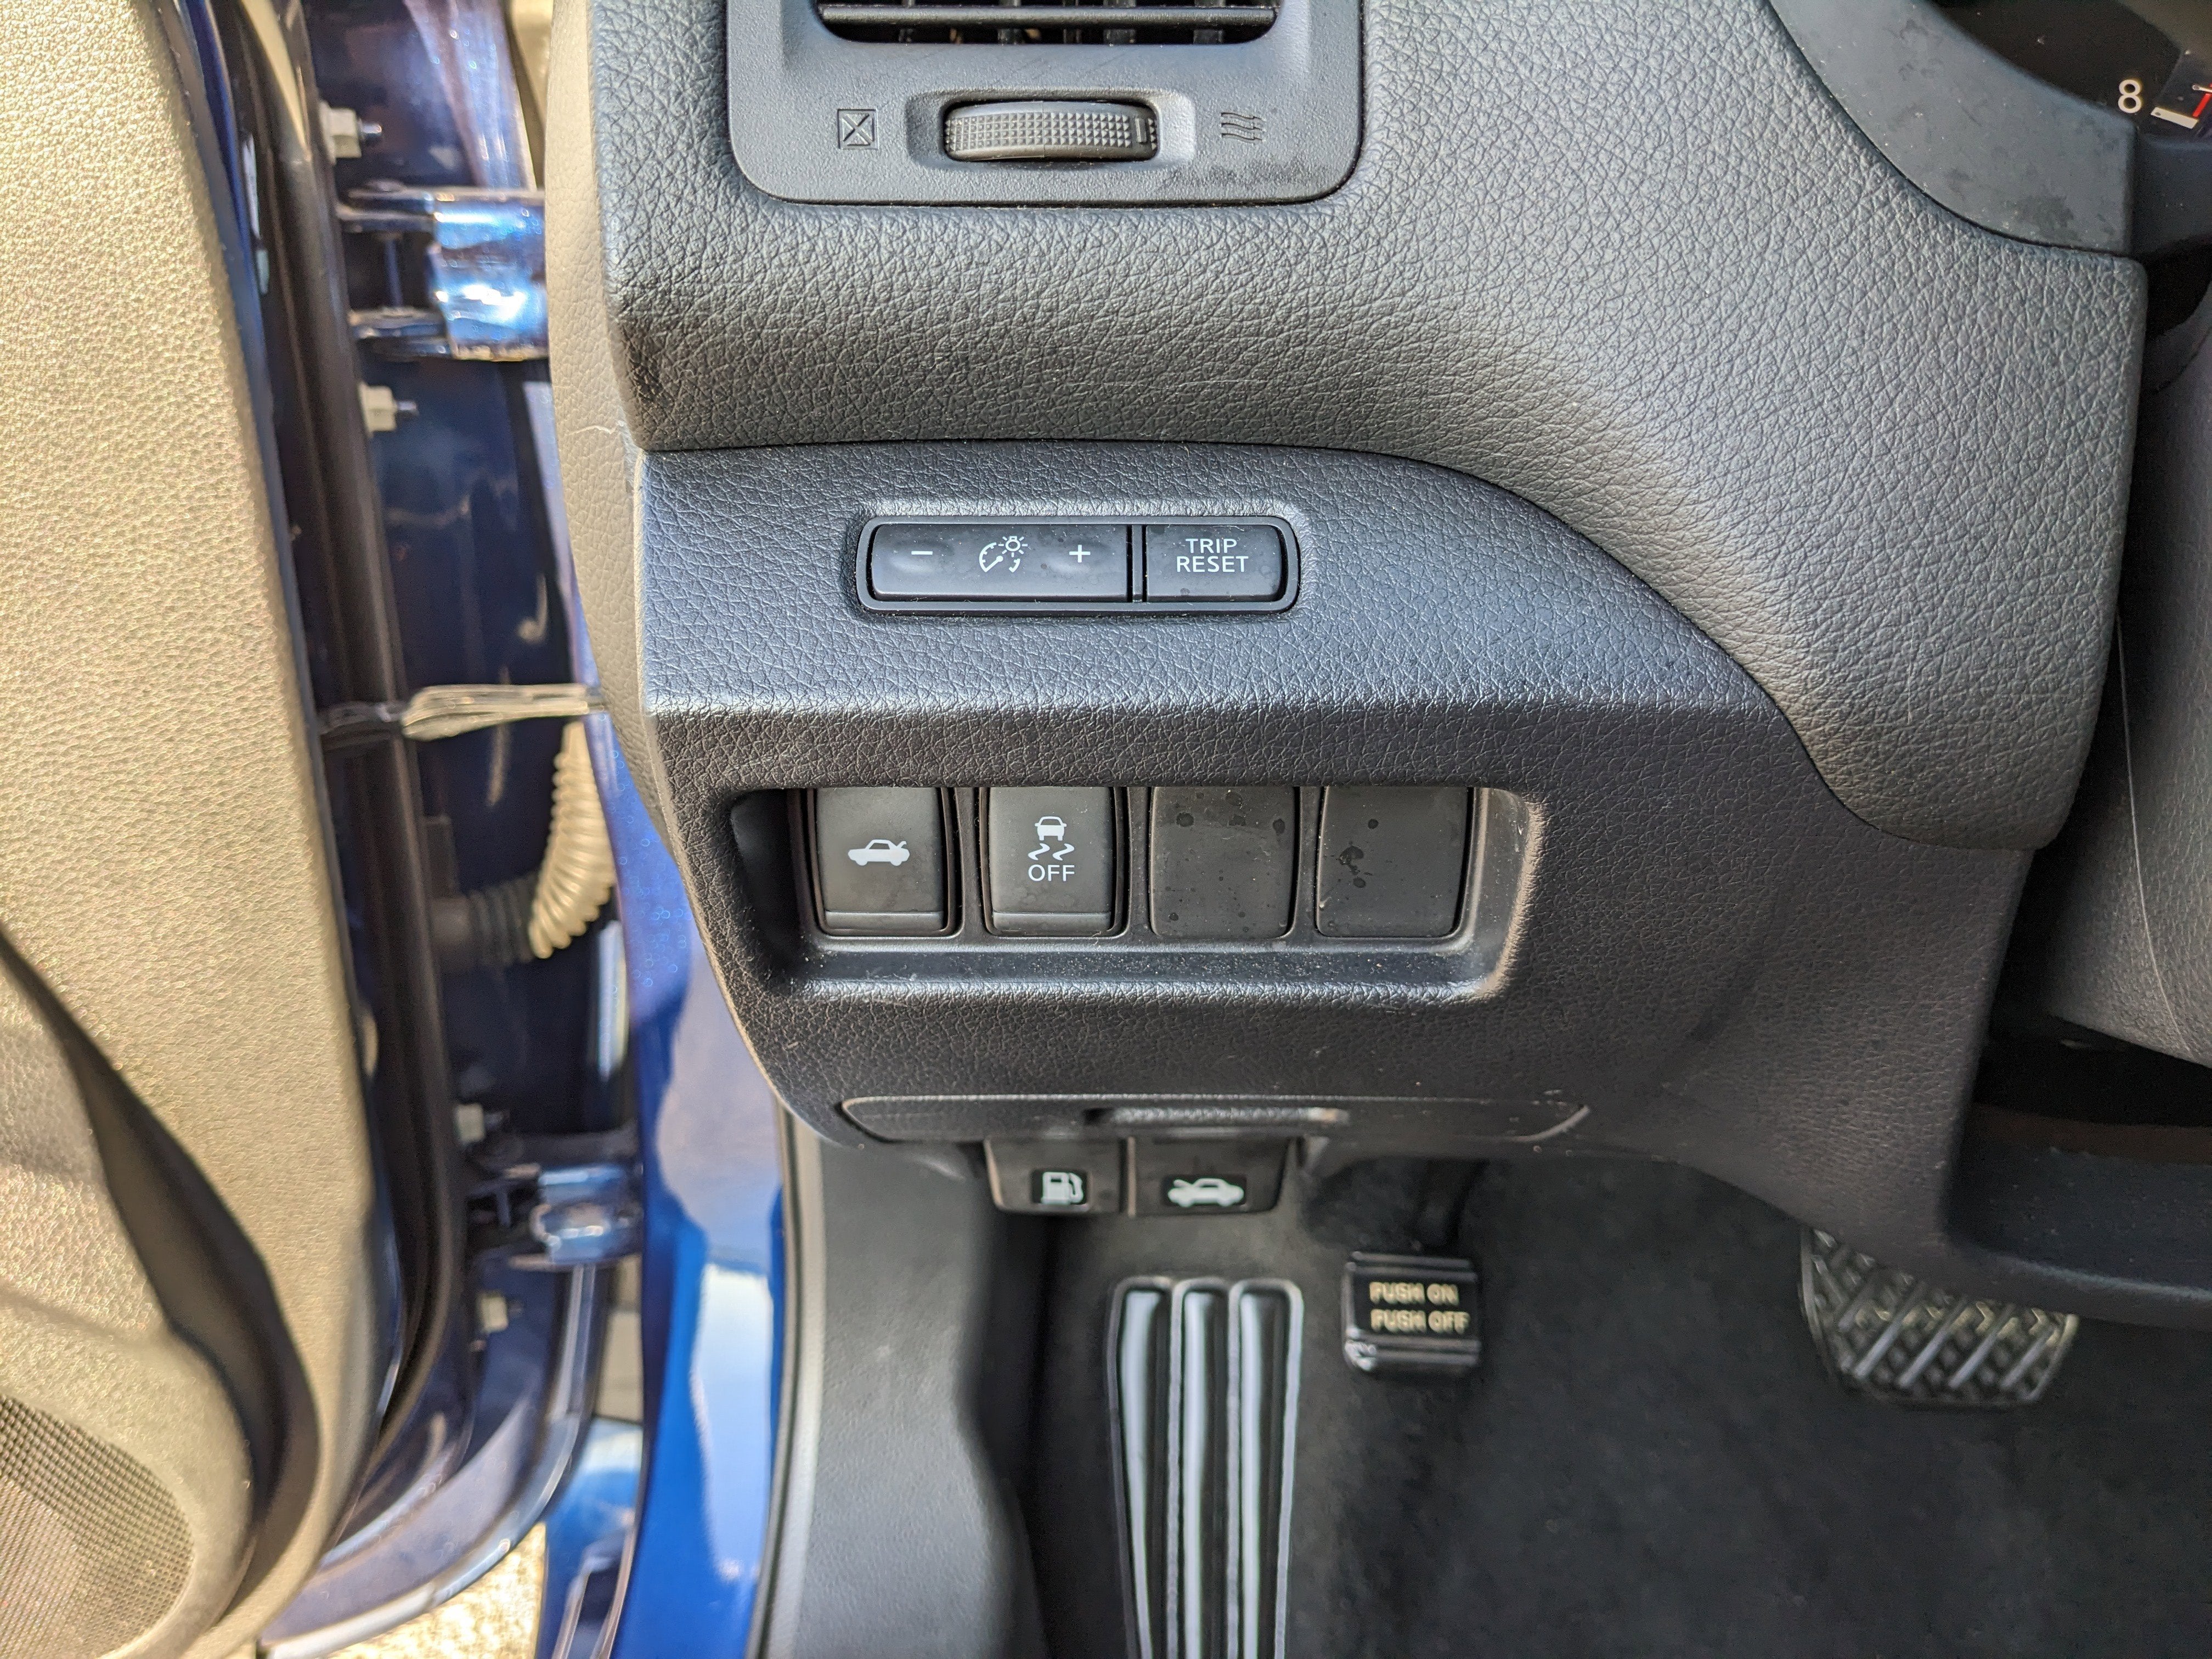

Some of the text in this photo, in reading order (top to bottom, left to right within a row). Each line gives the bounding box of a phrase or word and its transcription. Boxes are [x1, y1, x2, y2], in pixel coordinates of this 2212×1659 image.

[2118, 79, 2142, 114] 8
[1185, 538, 1237, 554] TRIP
[1177, 556, 1249, 572] RESET
[1028, 864, 1075, 882] OFF
[1369, 1282, 1459, 1306] PUSH ON
[1370, 1308, 1470, 1334] PUSH OFF
